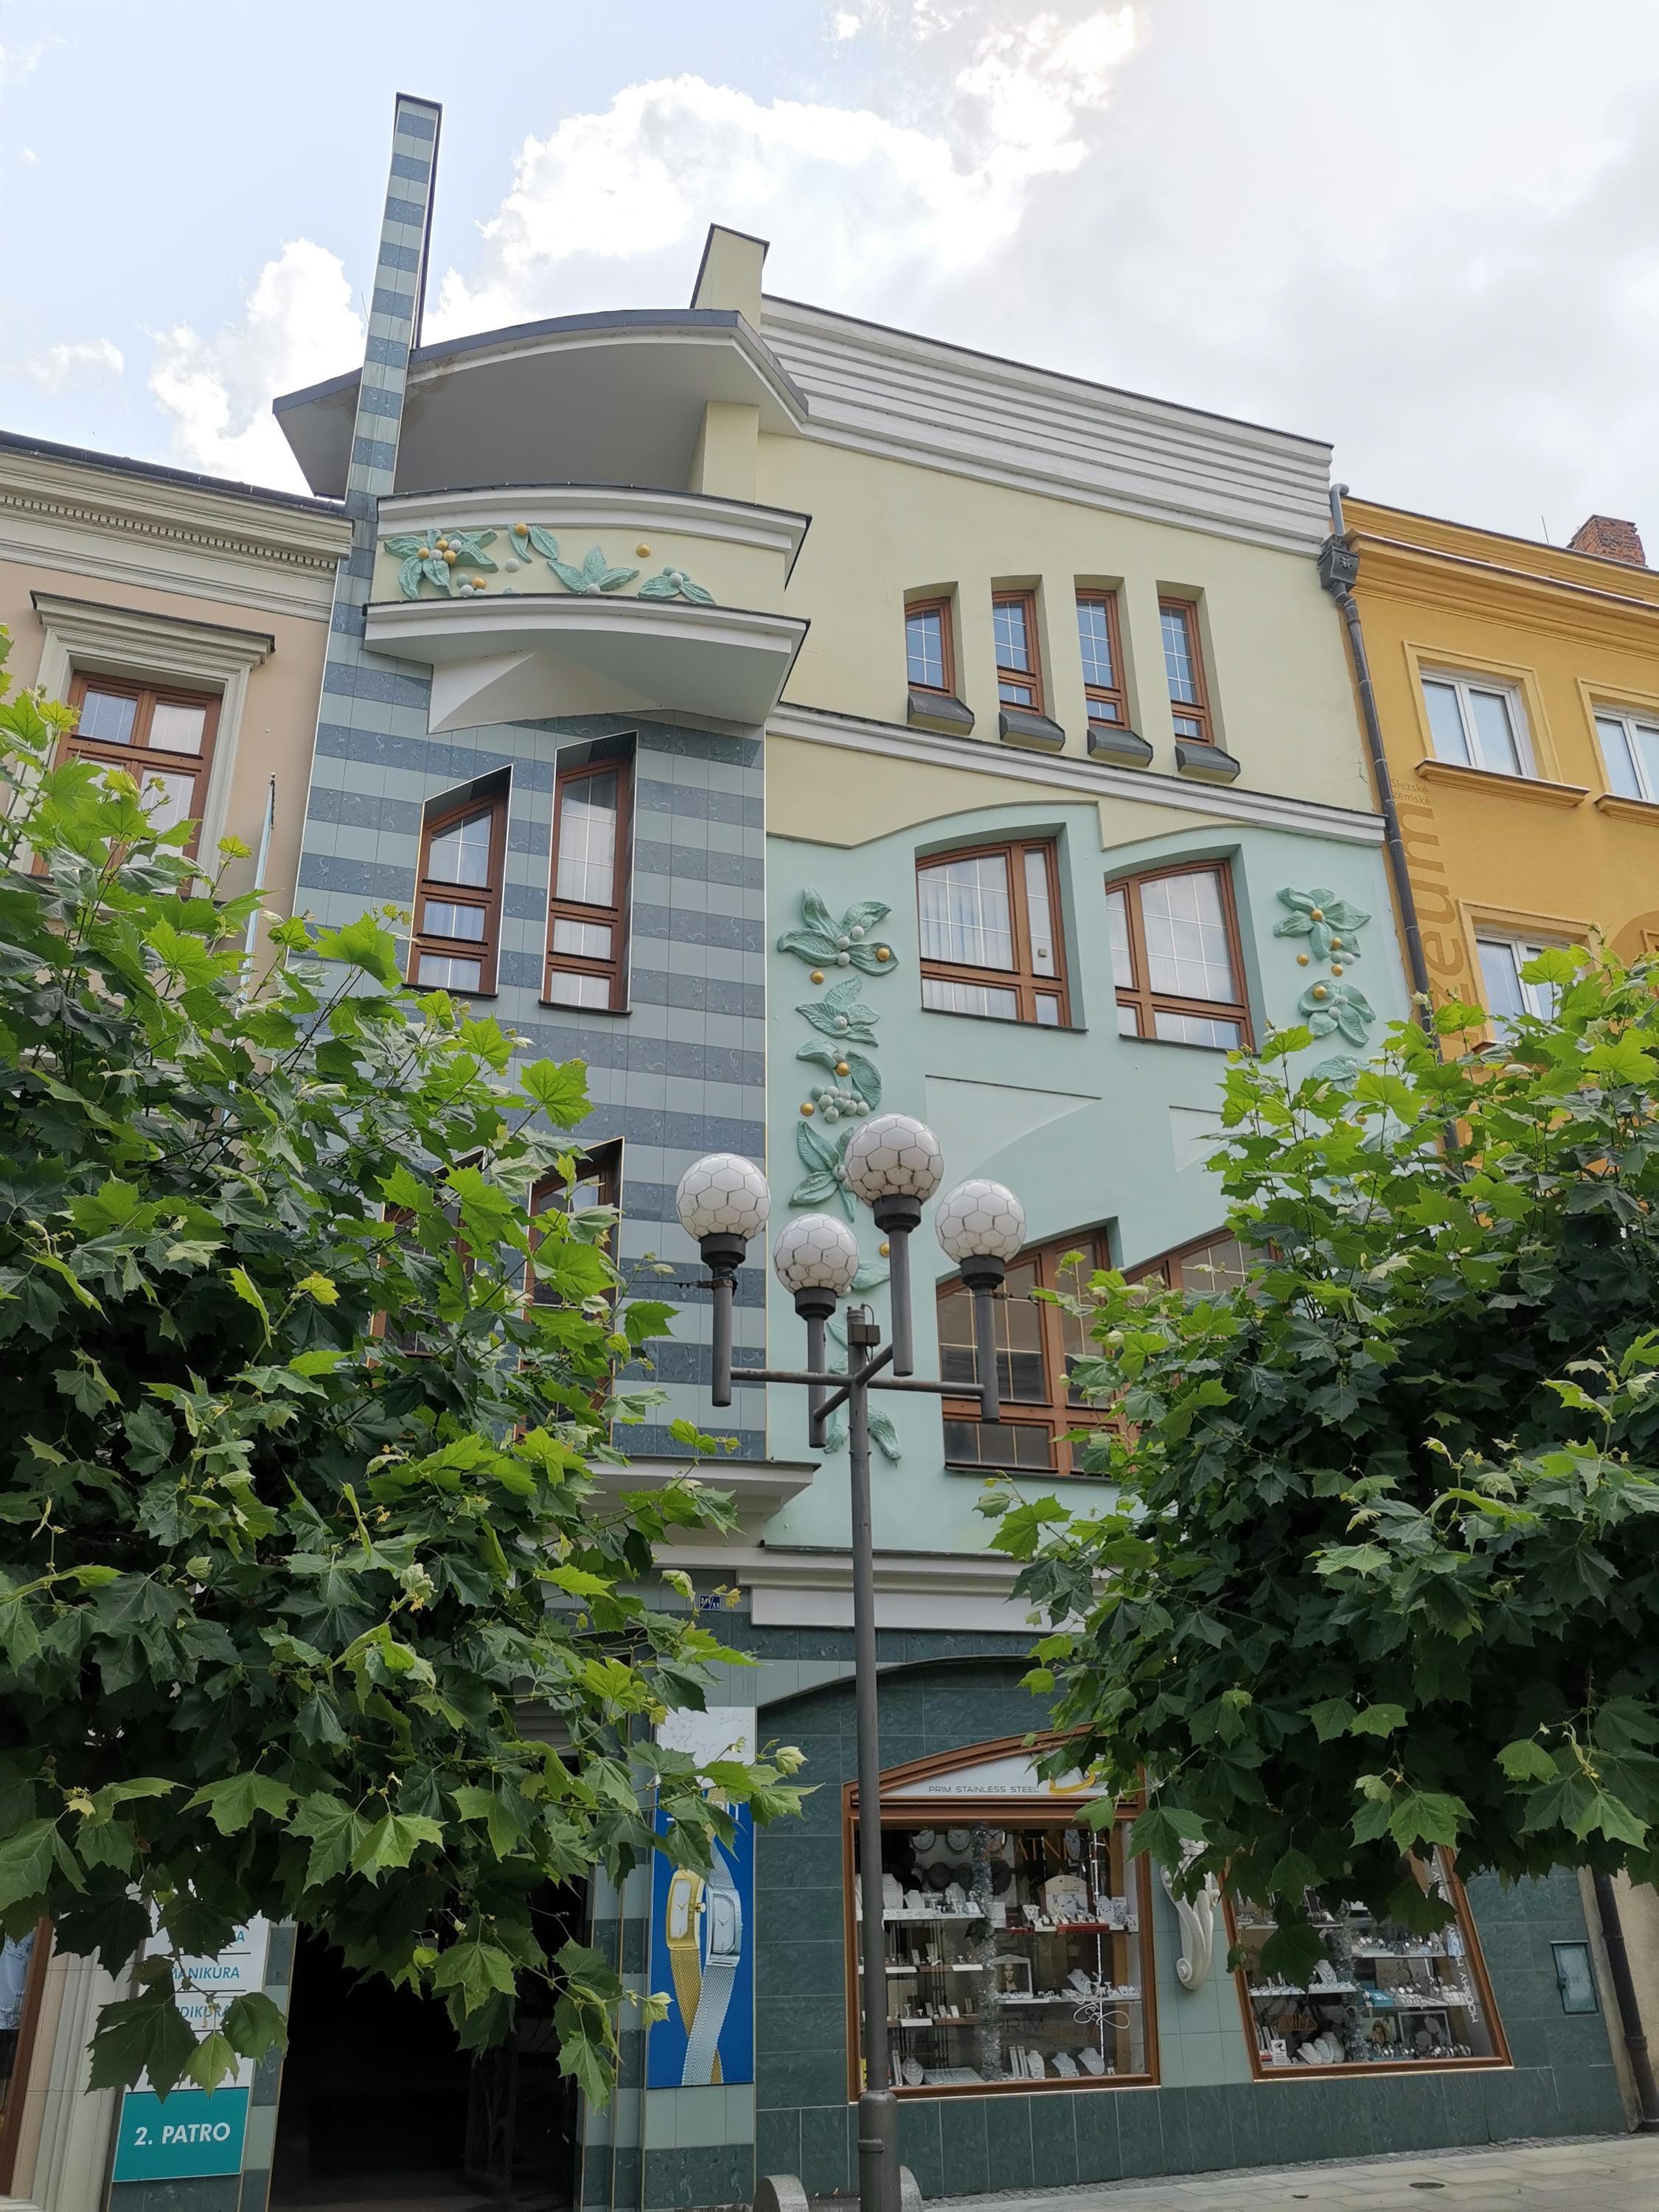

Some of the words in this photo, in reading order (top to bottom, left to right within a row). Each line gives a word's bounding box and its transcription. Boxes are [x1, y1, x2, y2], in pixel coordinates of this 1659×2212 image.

[1391, 779, 1428, 795] Slezské
[1393, 791, 1431, 806] zemské
[133, 2126, 153, 2146] 2.
[161, 2122, 231, 2144] PATRO
